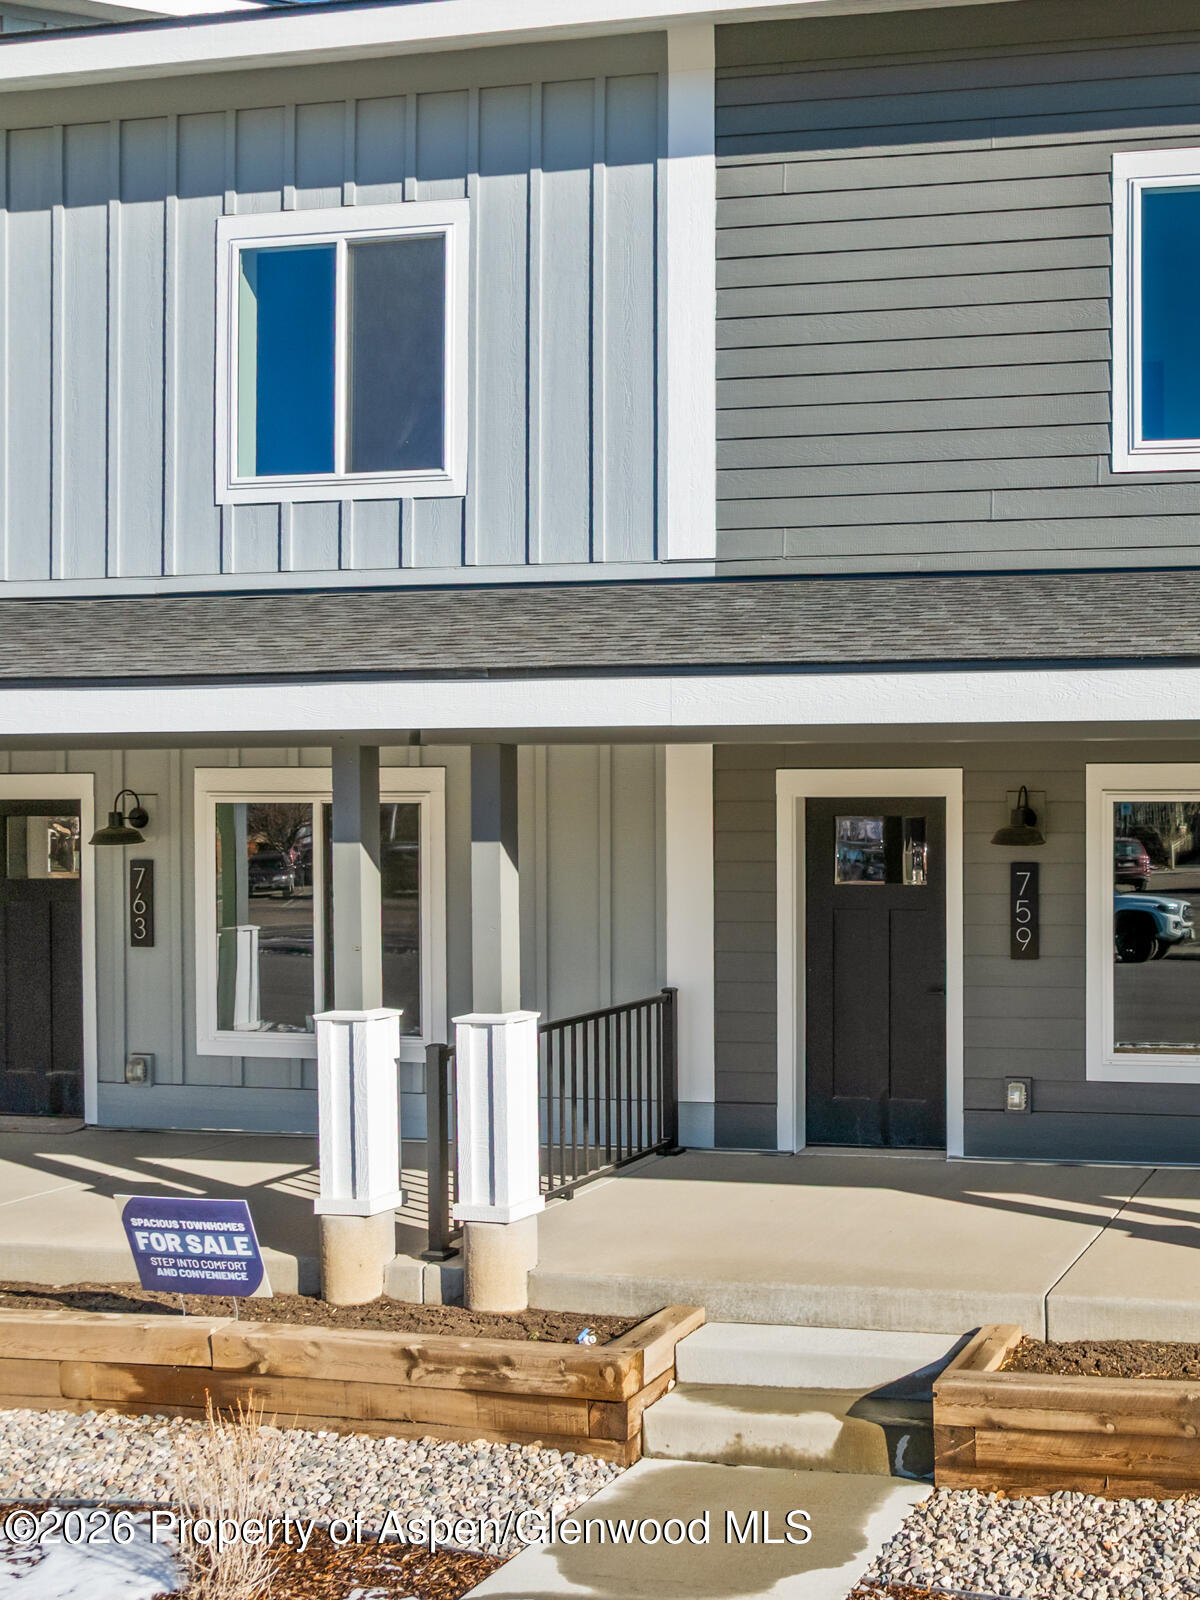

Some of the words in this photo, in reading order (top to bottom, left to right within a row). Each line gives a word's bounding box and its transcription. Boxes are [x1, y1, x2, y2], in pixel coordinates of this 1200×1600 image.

[132, 867, 146, 939] 763
[1015, 871, 1032, 951] 759
[130, 1217, 179, 1230] SPACIOUS
[180, 1219, 246, 1232] TOWNHOMES
[134, 1231, 184, 1253] FOR
[185, 1233, 253, 1256] SALE
[150, 1256, 175, 1267] STEP
[176, 1258, 200, 1269] INTO
[200, 1260, 247, 1271] COMFORT
[156, 1267, 178, 1277] AND
[178, 1269, 249, 1281] CONVENIENCE
